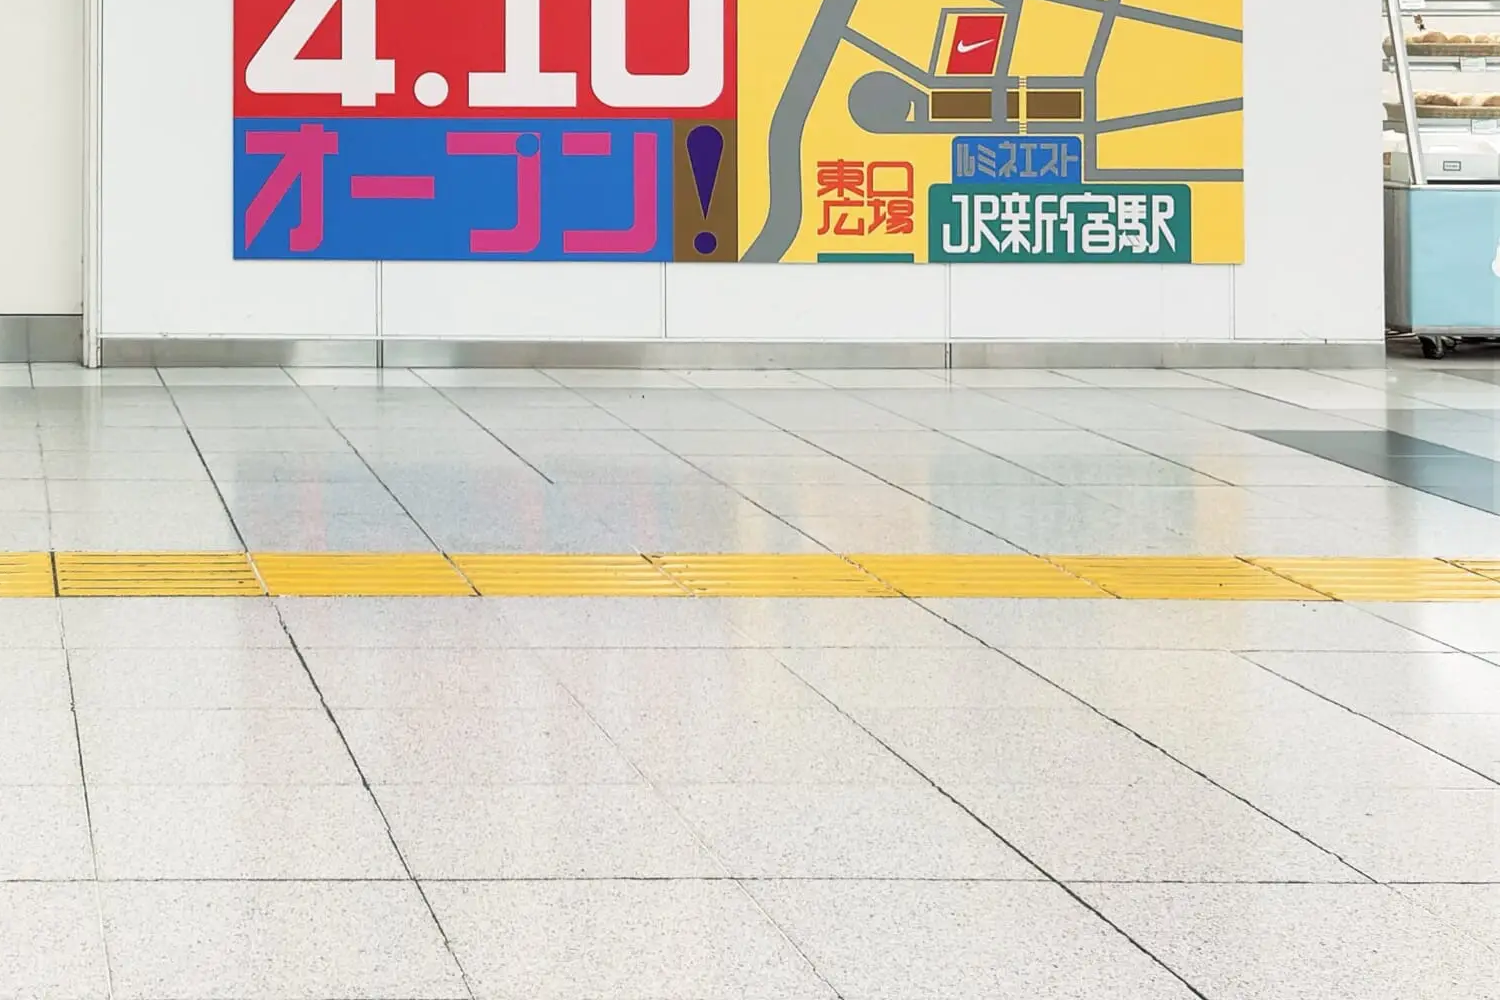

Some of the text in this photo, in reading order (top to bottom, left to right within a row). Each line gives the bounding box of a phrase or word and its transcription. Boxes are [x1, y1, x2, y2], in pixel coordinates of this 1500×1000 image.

[816, 159, 914, 198] 東口
[956, 141, 1080, 179] ルミネエスト
[816, 199, 914, 236] 広場
[942, 192, 1176, 254] JR新宿駅
